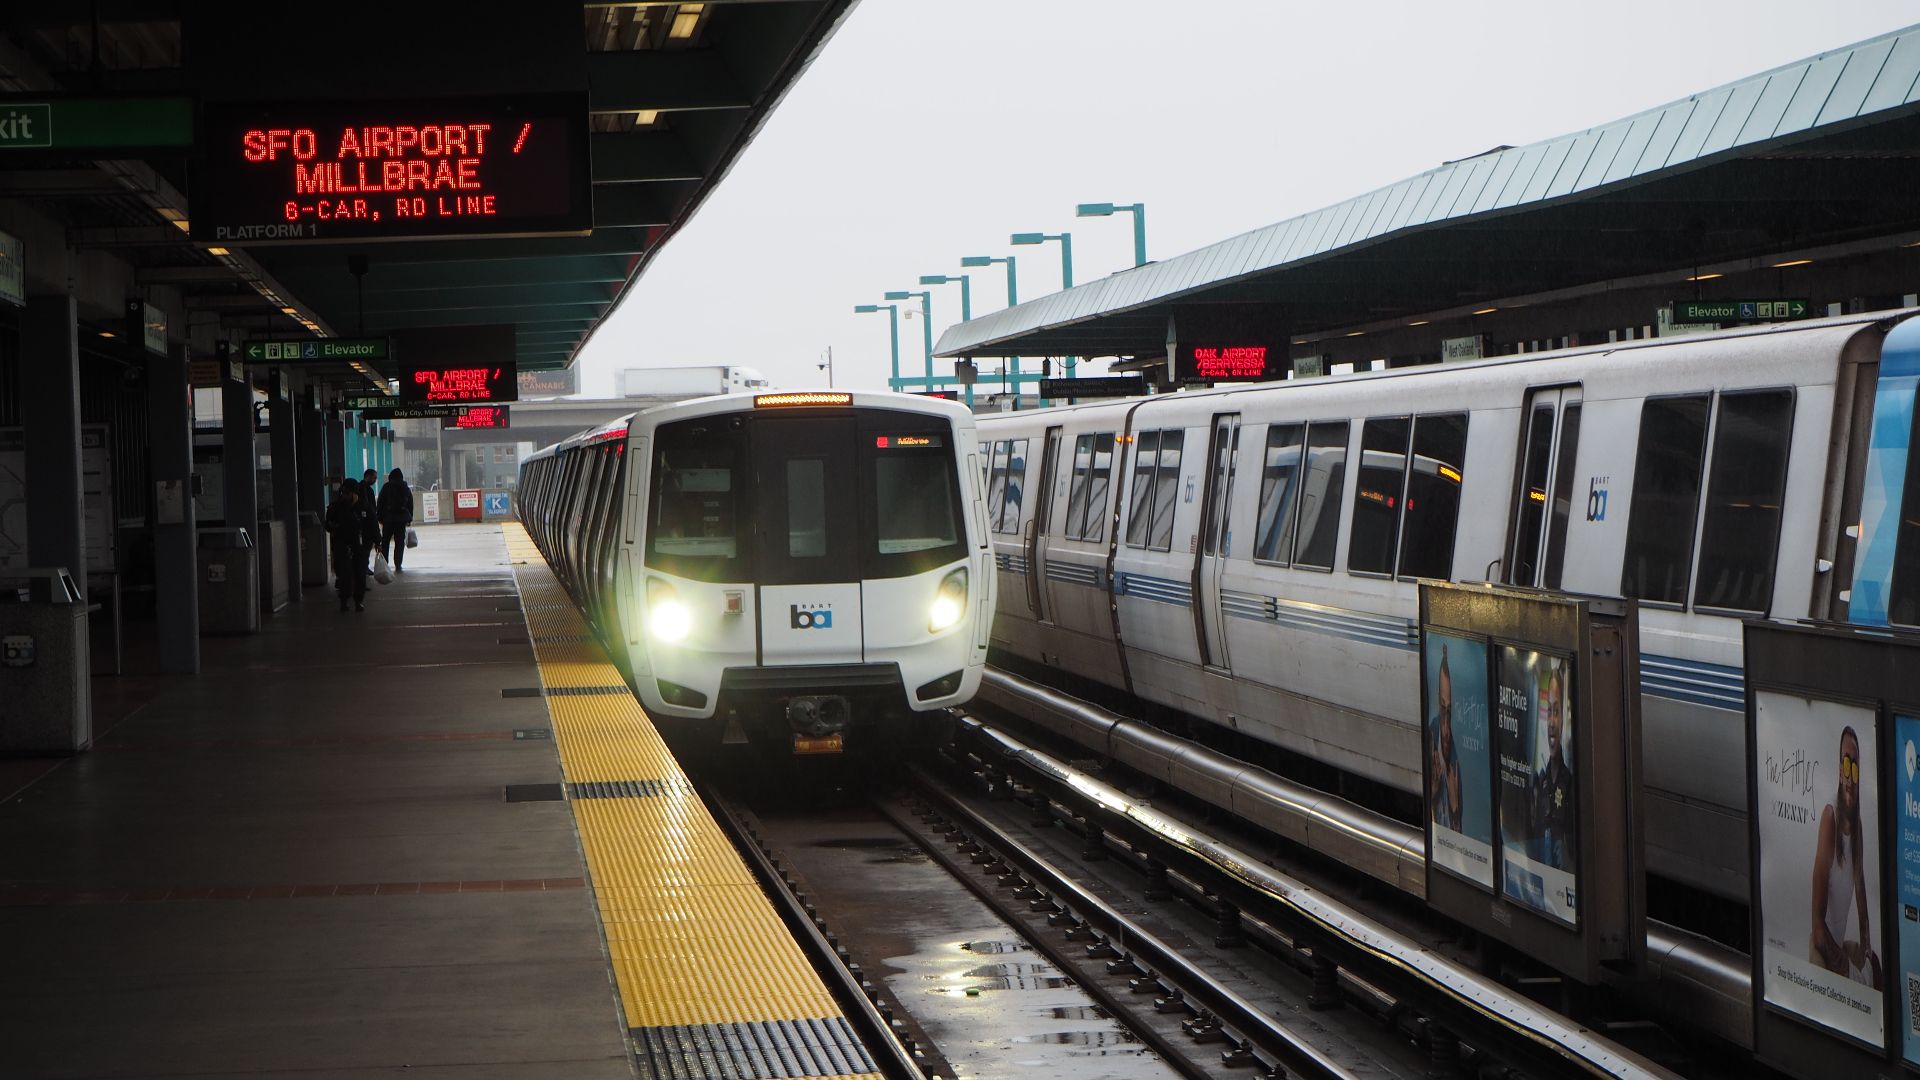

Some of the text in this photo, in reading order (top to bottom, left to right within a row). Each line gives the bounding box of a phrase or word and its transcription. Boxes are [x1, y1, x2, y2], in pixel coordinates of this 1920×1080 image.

[244, 123, 532, 161] SFO AIRPORT /
[296, 158, 481, 193] MILLBRAE
[285, 196, 497, 221] 6-CAR, RD LINE
[216, 223, 317, 239] PLATFORM 1
[1688, 305, 1735, 317] Elevator
[324, 344, 375, 355] Elevator
[1195, 347, 1267, 359] OAK AIRPORT
[415, 371, 438, 384] SFO
[443, 368, 489, 381] AIRPORT
[493, 367, 502, 380] /
[430, 380, 487, 393] MILLBRAE
[382, 398, 395, 406] Exit
[394, 410, 407, 418] Daly
[410, 409, 422, 417] City,
[492, 498, 501, 509] K
[1512, 689, 1527, 711] Police
[1503, 709, 1518, 738] hiring
[1777, 965, 1787, 981] Shop
[1794, 972, 1810, 988] Exclusive
[1810, 979, 1827, 995] Eyewear
[1827, 986, 1847, 1004] Collection
